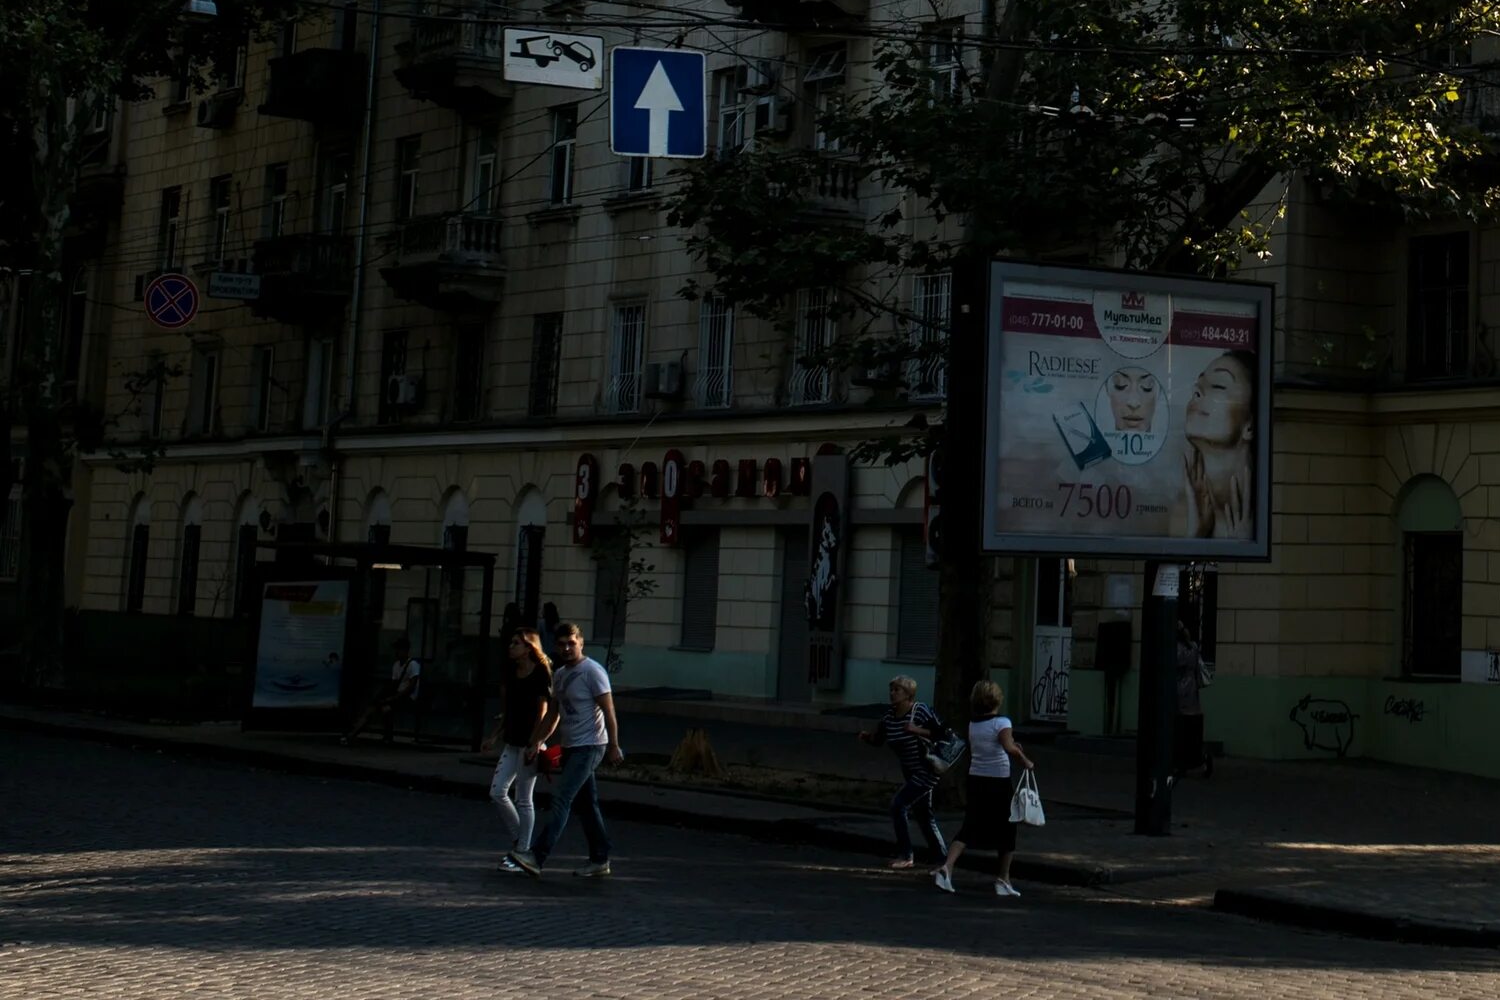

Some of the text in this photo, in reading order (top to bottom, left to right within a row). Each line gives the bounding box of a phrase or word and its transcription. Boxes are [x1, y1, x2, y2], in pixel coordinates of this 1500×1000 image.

[1031, 312, 1084, 330] 777-01-00
[1104, 310, 1162, 326] МультиМед
[1201, 326, 1250, 343] 484-43-21
[1028, 350, 1100, 377] RADIESSE
[1121, 433, 1143, 455] 10
[1012, 497, 1043, 509] ВСЕГО
[1058, 483, 1132, 520] 7500
